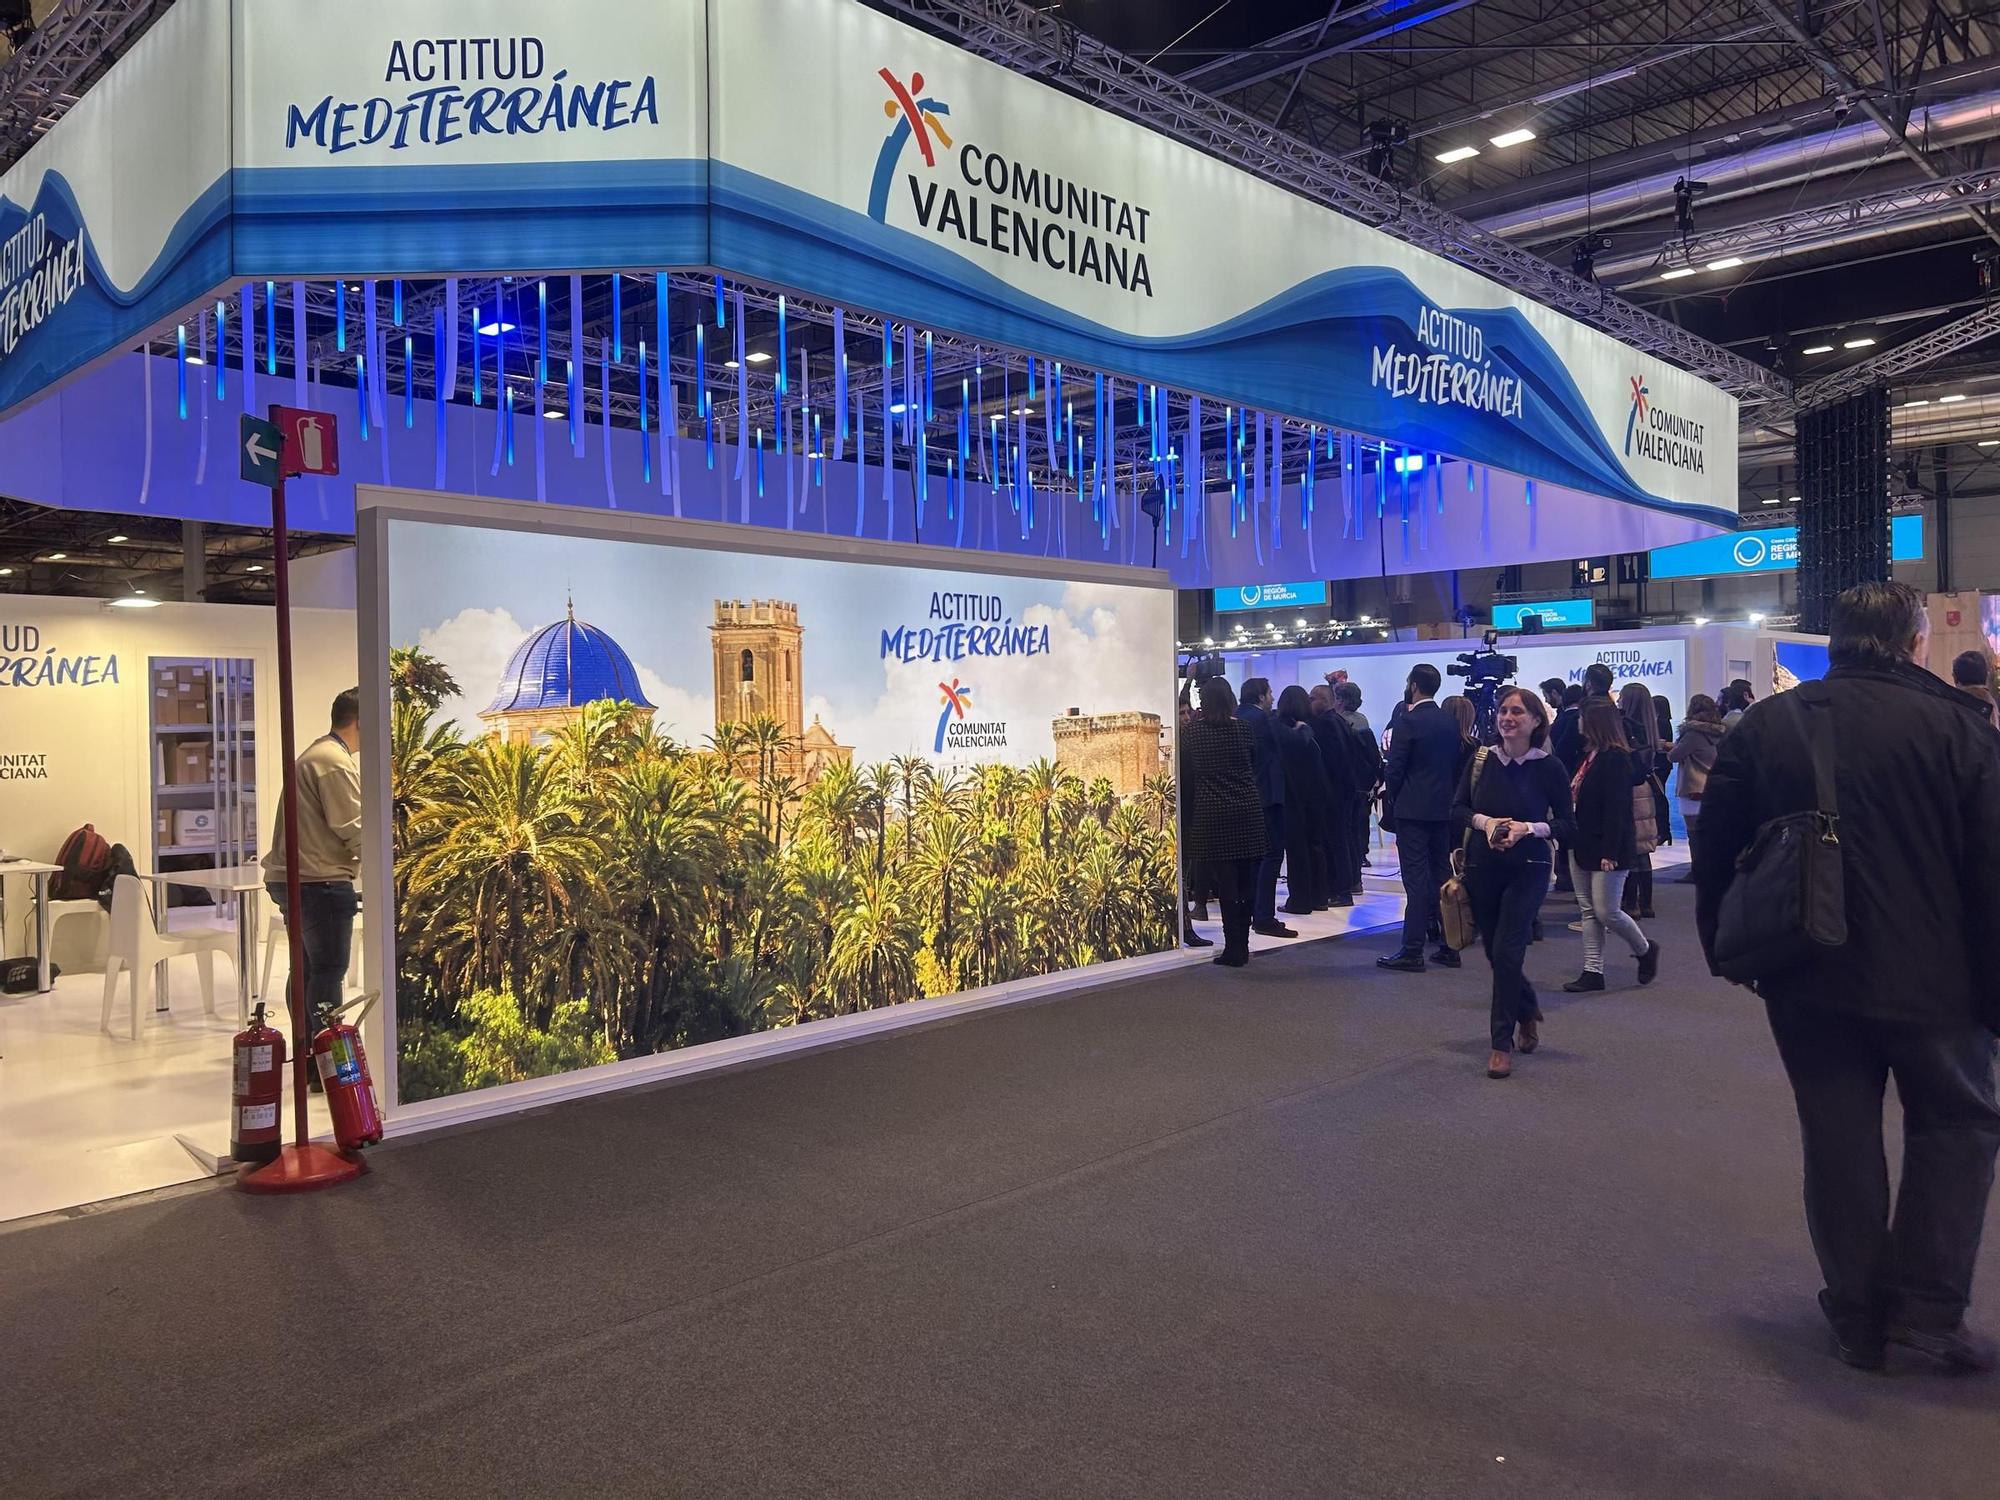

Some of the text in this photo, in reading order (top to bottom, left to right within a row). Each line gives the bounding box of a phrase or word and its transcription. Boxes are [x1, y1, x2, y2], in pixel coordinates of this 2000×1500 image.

[385, 37, 545, 82] ACTITUD
[286, 69, 660, 154] MEDITERRÁNEA
[960, 144, 1151, 244] COMUNITAT
[909, 174, 1154, 298] VALENCIANA
[1417, 305, 1483, 364] ACTITUD
[1371, 344, 1523, 419] MEDITERRÁNEA
[1650, 407, 1704, 445] COMUNITAT
[1636, 428, 1704, 475] VALENCIANA
[1770, 553, 1784, 561] DE
[929, 592, 1002, 622] ACTITUD
[880, 618, 1050, 663] MEDITERRÁNEA
[1596, 650, 1641, 664] ACTITUD
[947, 735, 1007, 749] VALENCIANA
[949, 722, 1007, 736] COMUNITAT
[0, 754, 47, 767] NITAT
